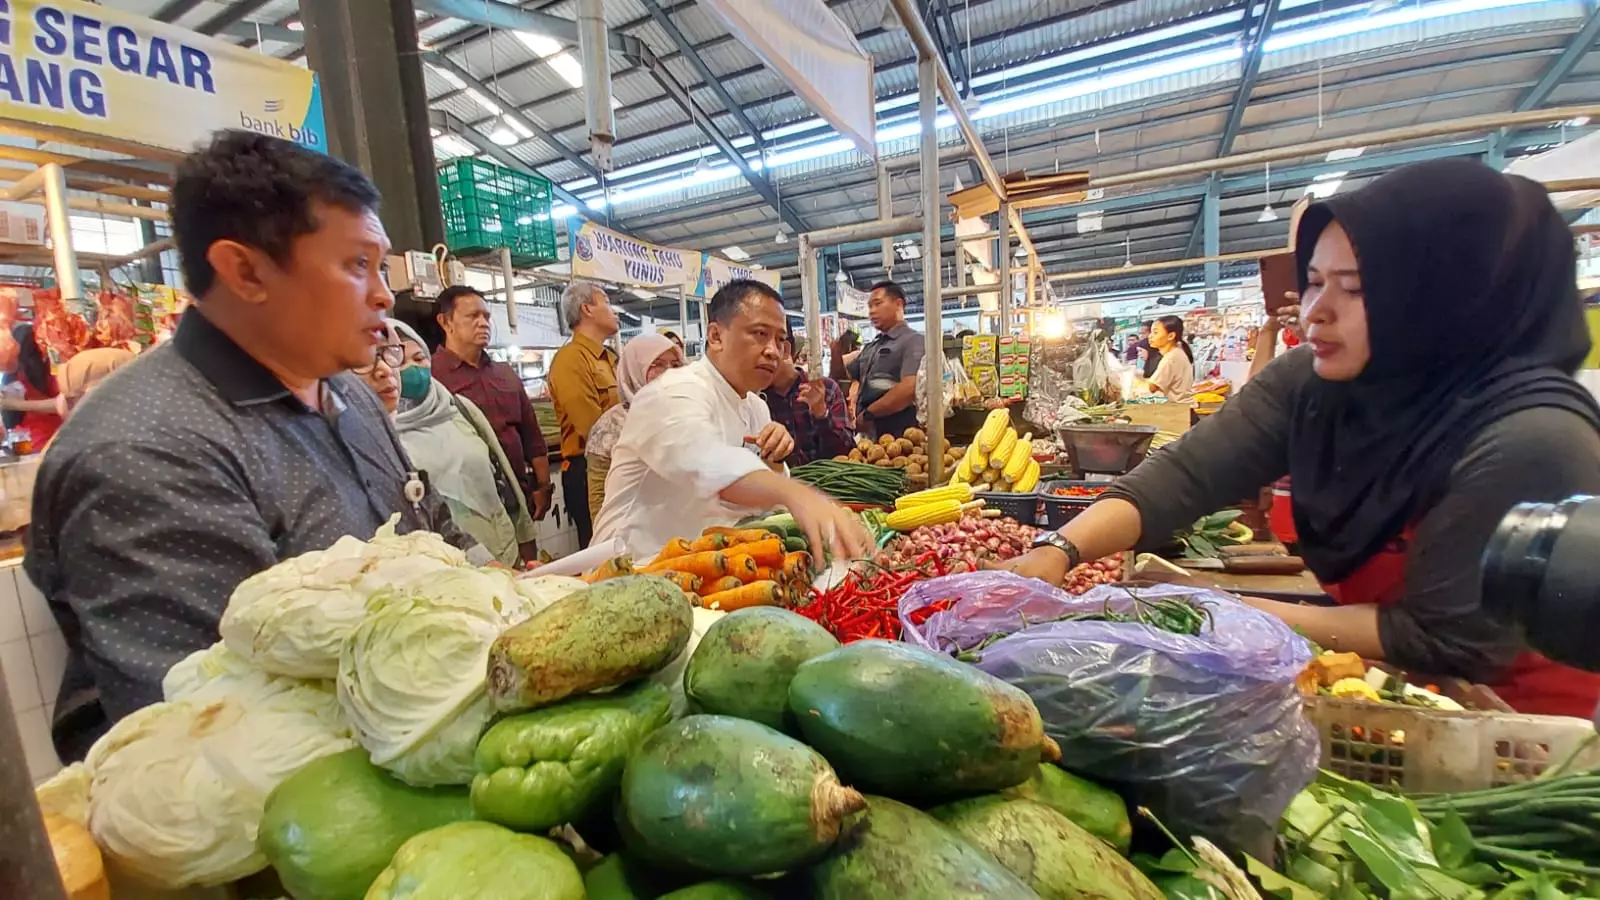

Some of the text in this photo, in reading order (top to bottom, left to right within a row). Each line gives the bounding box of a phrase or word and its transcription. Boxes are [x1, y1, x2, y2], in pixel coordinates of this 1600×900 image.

[34, 7, 216, 94] SEGAR
[240, 109, 318, 146] bank bjb
[592, 231, 683, 269] WARUNG TAHU
[624, 260, 665, 285] YUNUS
